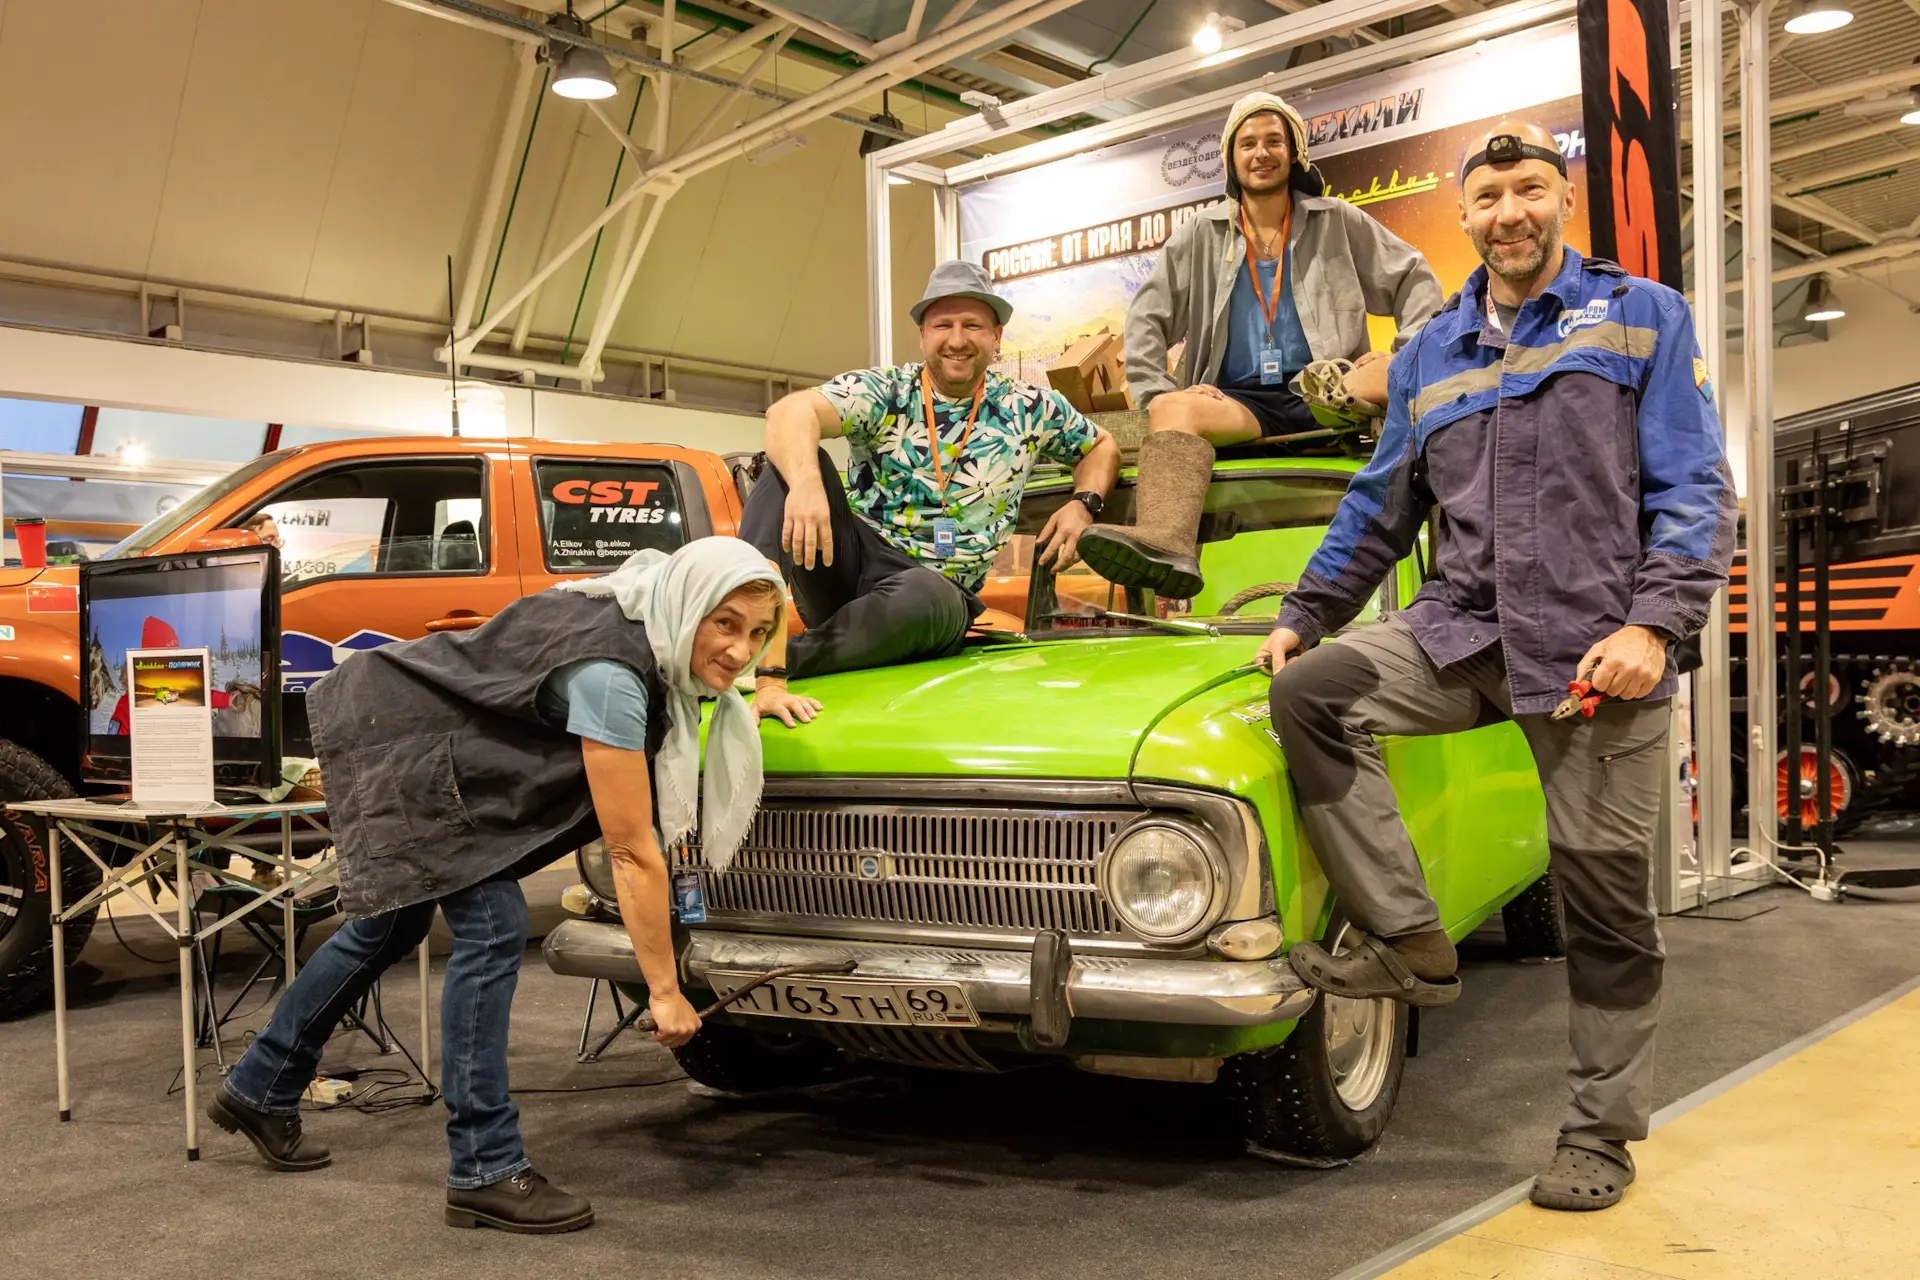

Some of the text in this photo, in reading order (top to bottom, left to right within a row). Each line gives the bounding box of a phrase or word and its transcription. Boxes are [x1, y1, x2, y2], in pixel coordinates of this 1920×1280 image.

[1302, 88, 1425, 148] ЕХАЛИ
[1061, 232, 1083, 264] ОТ
[1087, 220, 1133, 258] КРАЯ
[1137, 213, 1165, 250] ДО
[552, 480, 659, 506] CST
[590, 507, 665, 524] TYRES
[553, 540, 631, 549] A.Elikov @a.elikov
[554, 549, 595, 557] A.Zhirukhin
[905, 988, 949, 1013] 69
[913, 1011, 946, 1023] RUS
